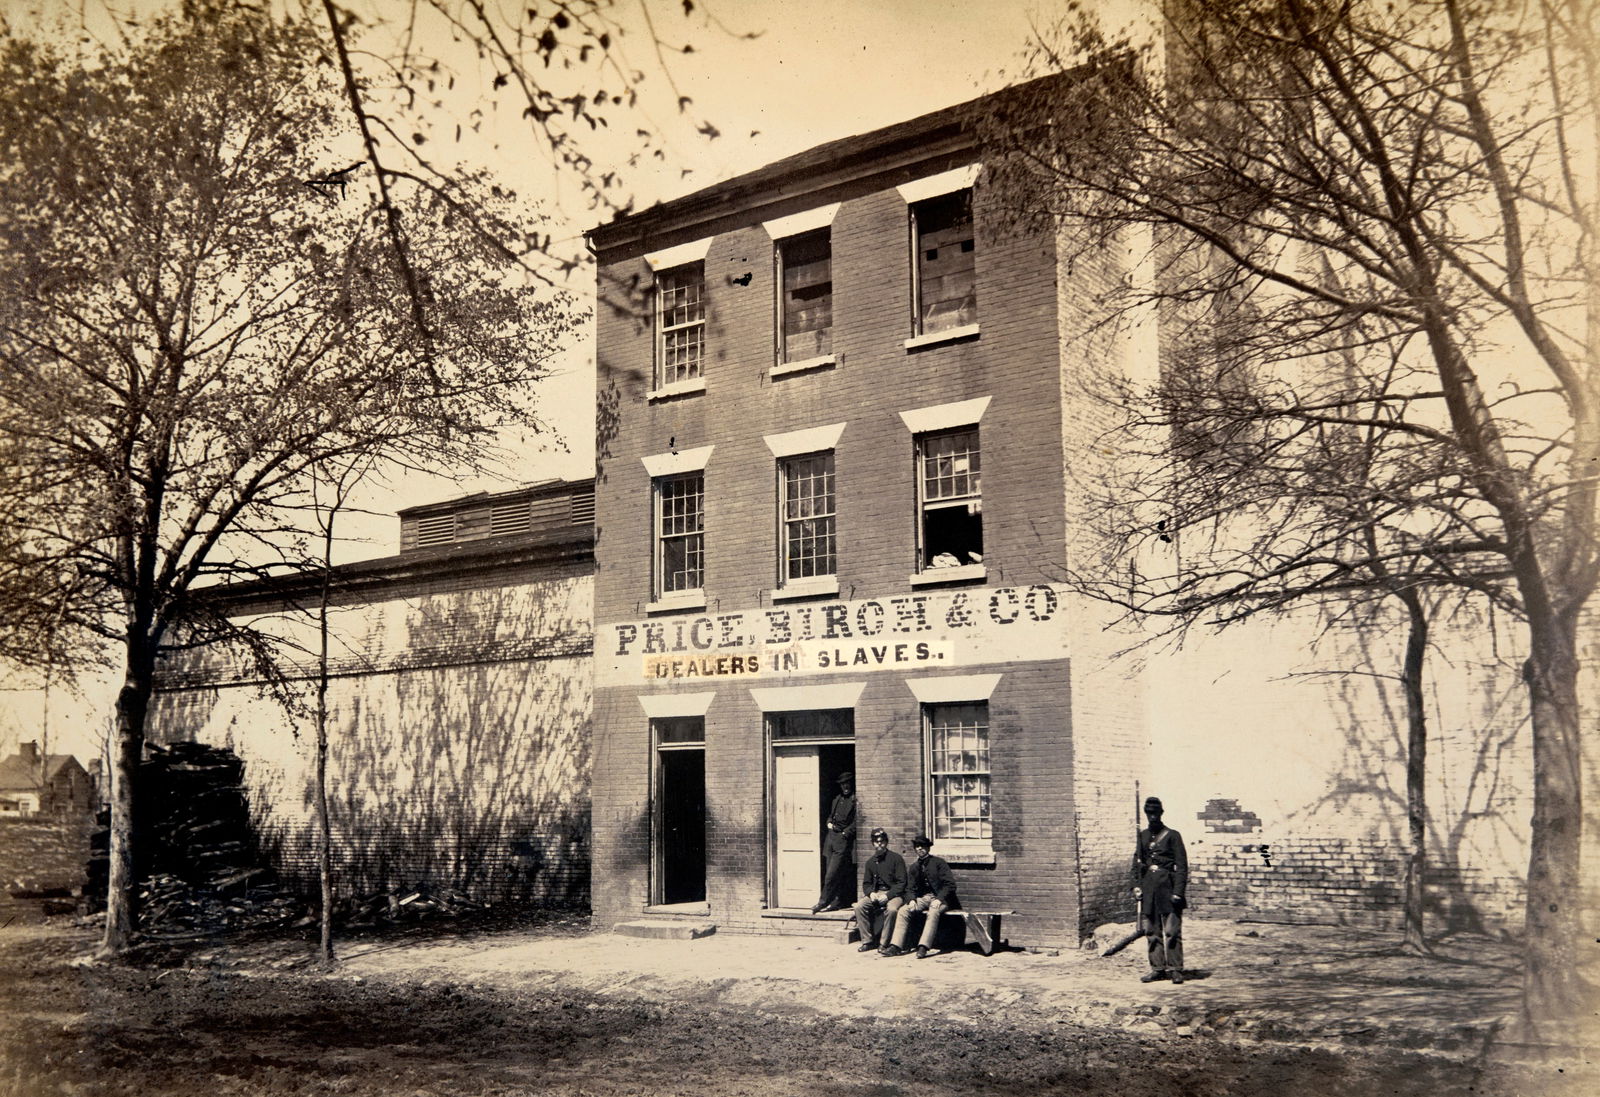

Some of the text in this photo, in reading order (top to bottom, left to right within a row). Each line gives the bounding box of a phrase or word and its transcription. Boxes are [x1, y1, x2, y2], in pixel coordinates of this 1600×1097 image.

[765, 596, 932, 644] BIRCH
[946, 593, 977, 628] &
[989, 584, 1058, 625] CO
[656, 656, 760, 679] DEALERS
[774, 651, 799, 671] IN
